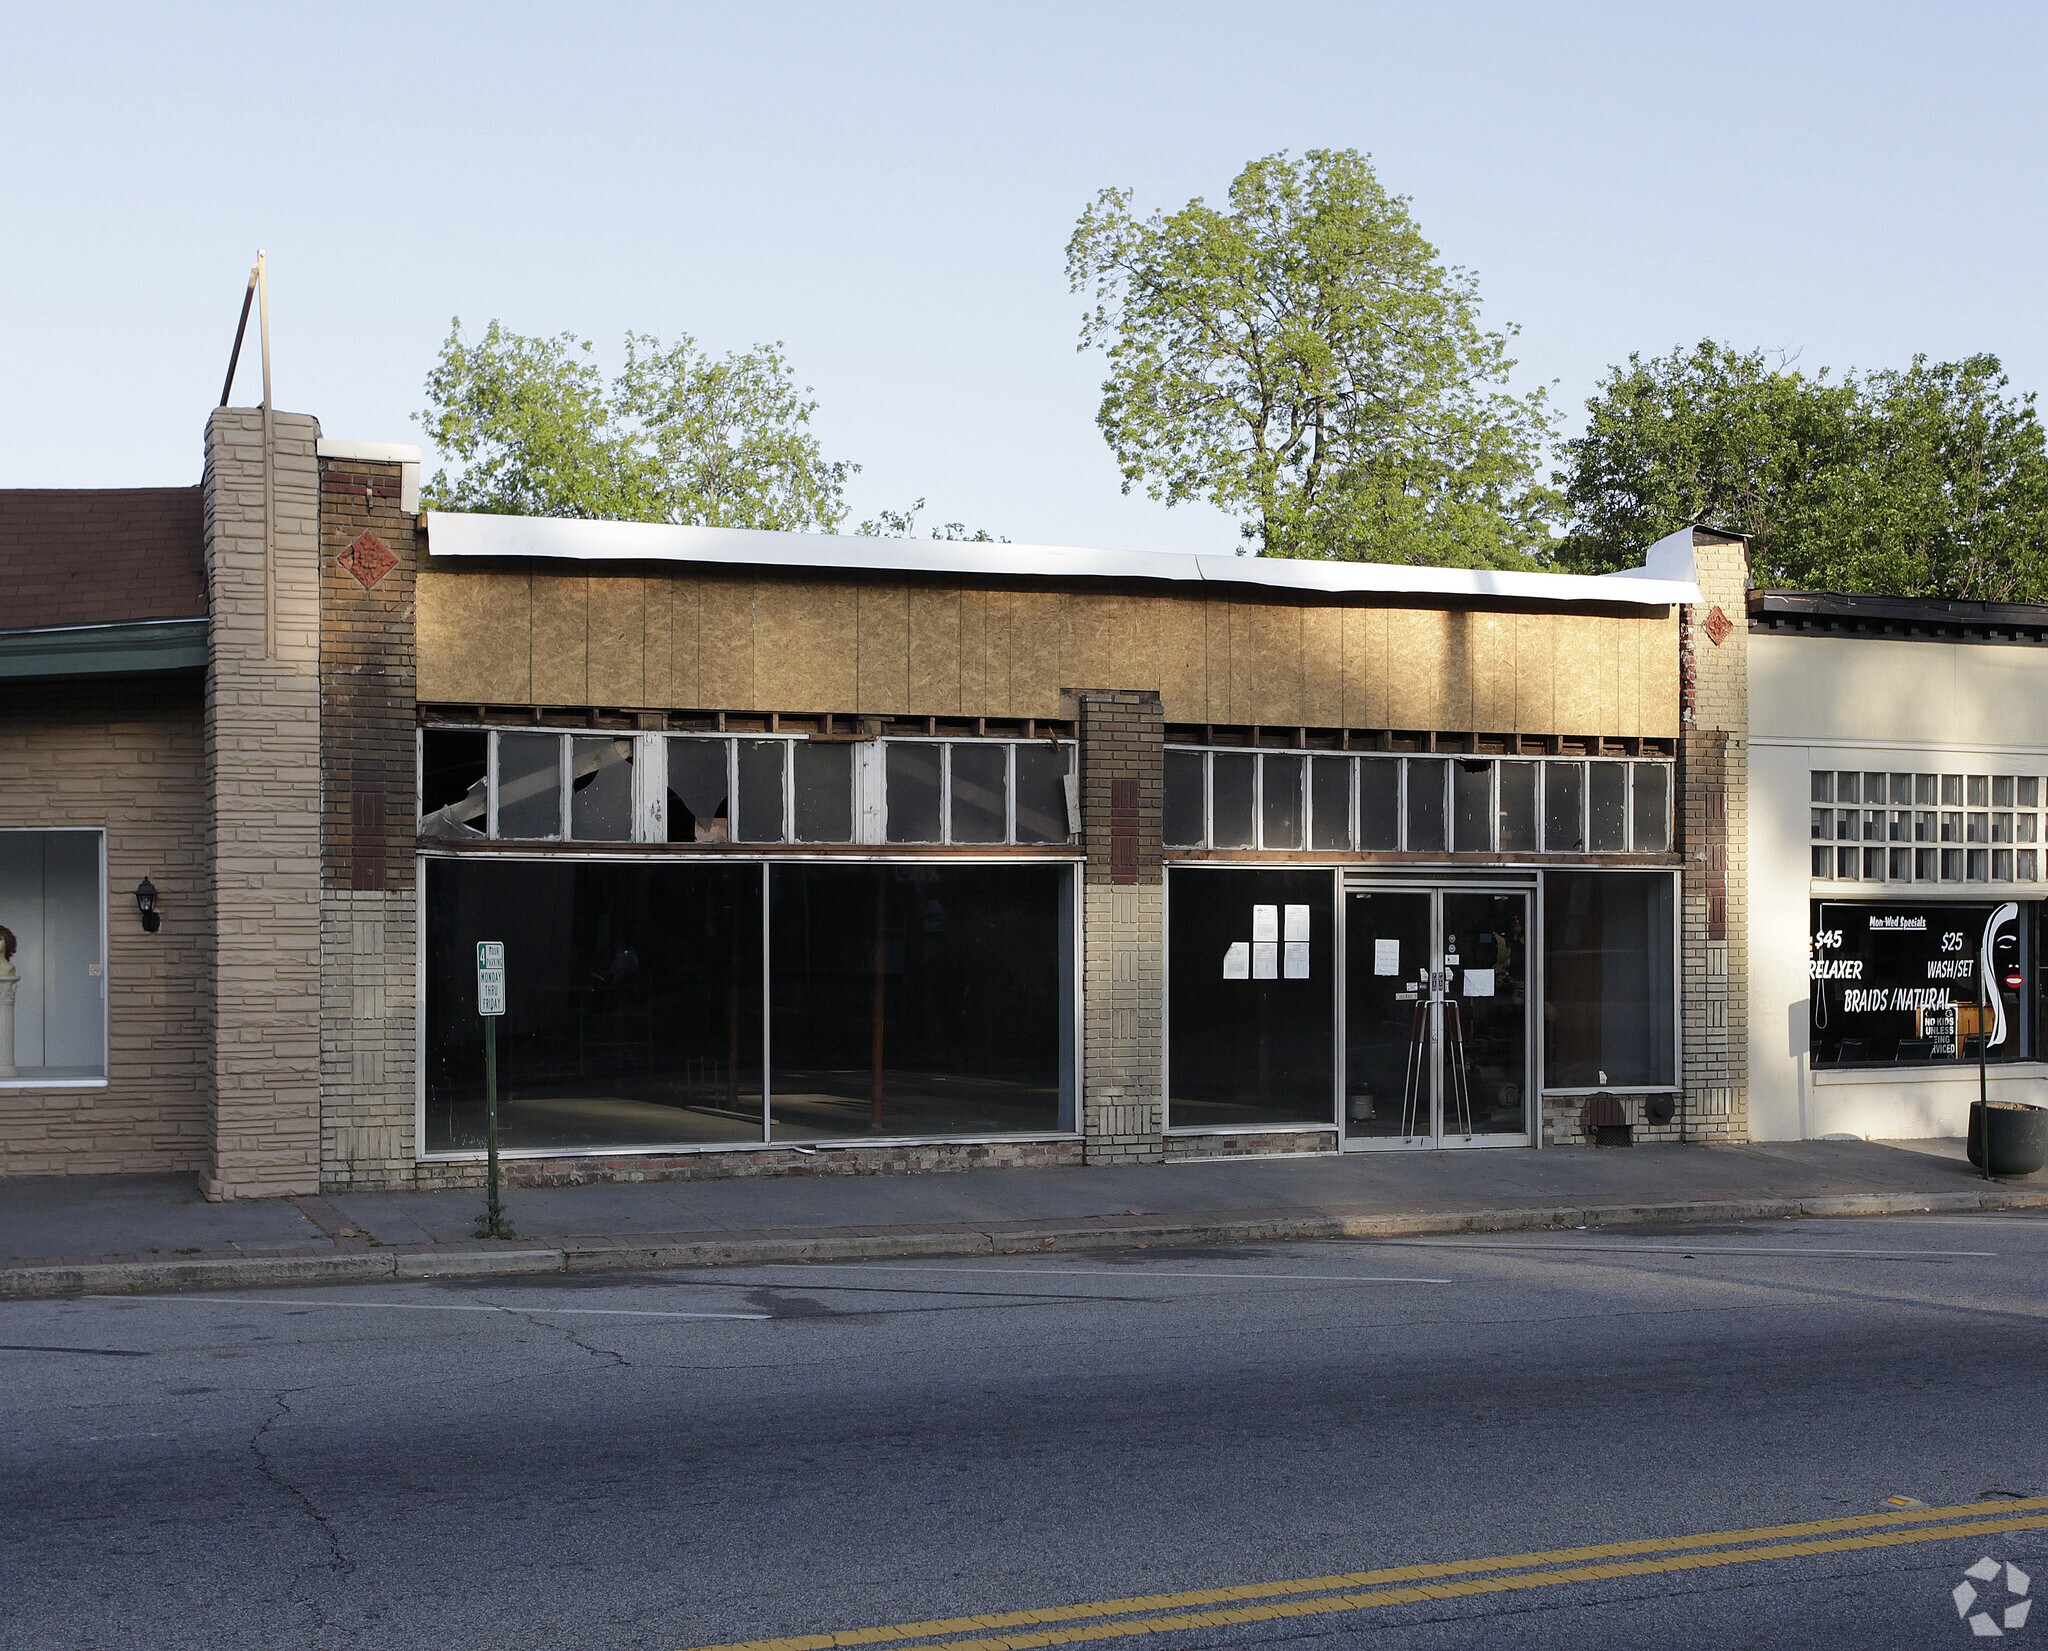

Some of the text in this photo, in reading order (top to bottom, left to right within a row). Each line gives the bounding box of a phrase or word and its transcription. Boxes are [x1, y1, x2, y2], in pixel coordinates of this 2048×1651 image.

[1870, 915, 1926, 930] Mon-Wed Specials
[1814, 929, 1843, 950] $45
[1941, 932, 1964, 952] $25
[480, 948, 485, 965] 4
[1809, 959, 1863, 980] RELAXER
[1927, 960, 1974, 979] WASH/SET
[481, 972, 501, 983] MONDAY
[485, 985, 498, 996] THRU
[483, 998, 501, 1009] FRIDAY
[1844, 988, 1889, 1013] BRAIDS
[1924, 1017, 1954, 1026] NO KIDS
[1925, 1026, 1954, 1035] UNLESS
[1928, 1035, 1950, 1044] EING
